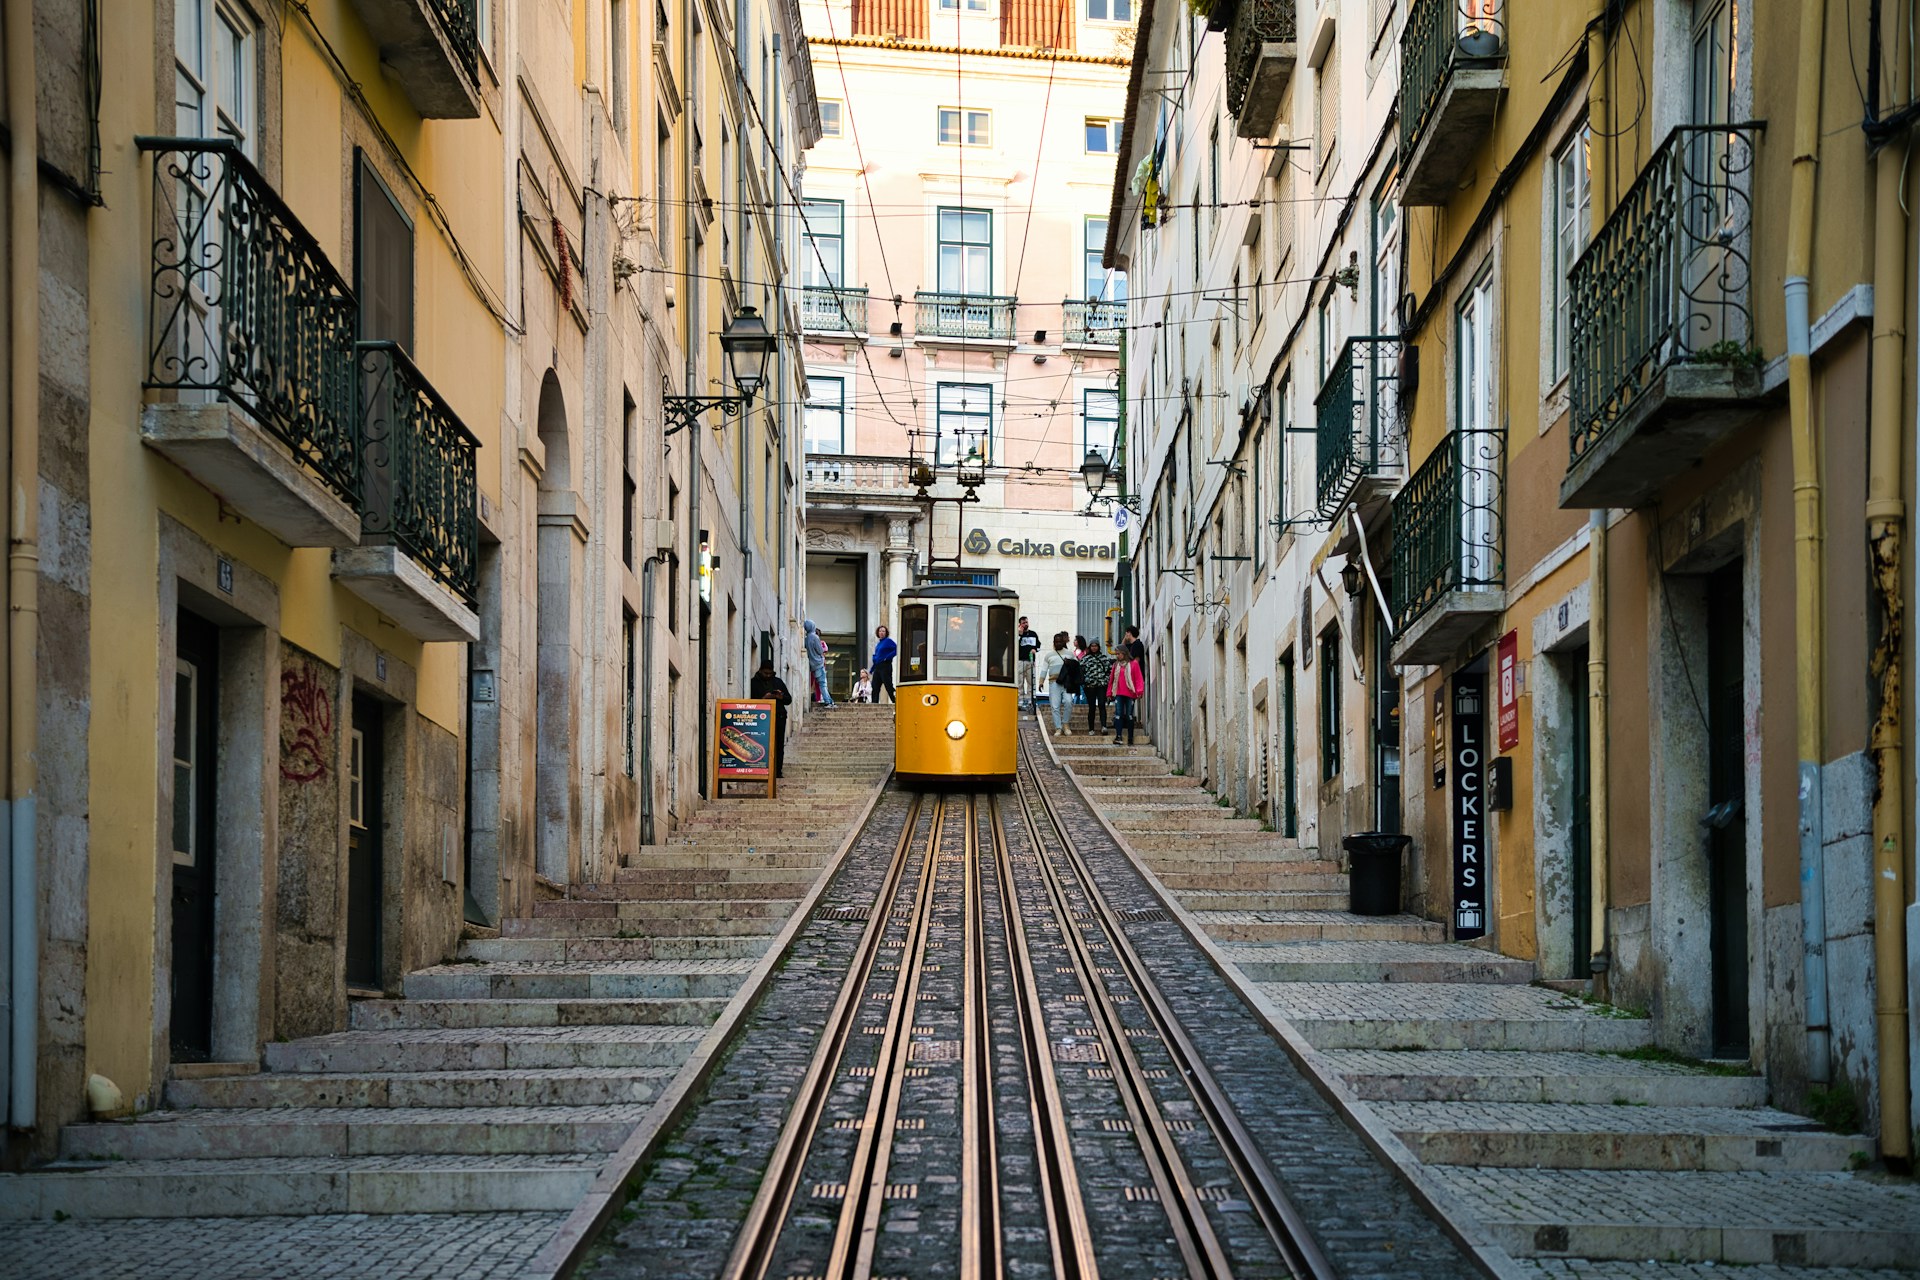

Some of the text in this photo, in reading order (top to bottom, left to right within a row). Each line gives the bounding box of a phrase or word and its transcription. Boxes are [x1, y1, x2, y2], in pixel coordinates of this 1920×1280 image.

[997, 538, 1116, 559] Caixa Geral
[1459, 725, 1478, 887] LOCKERS
